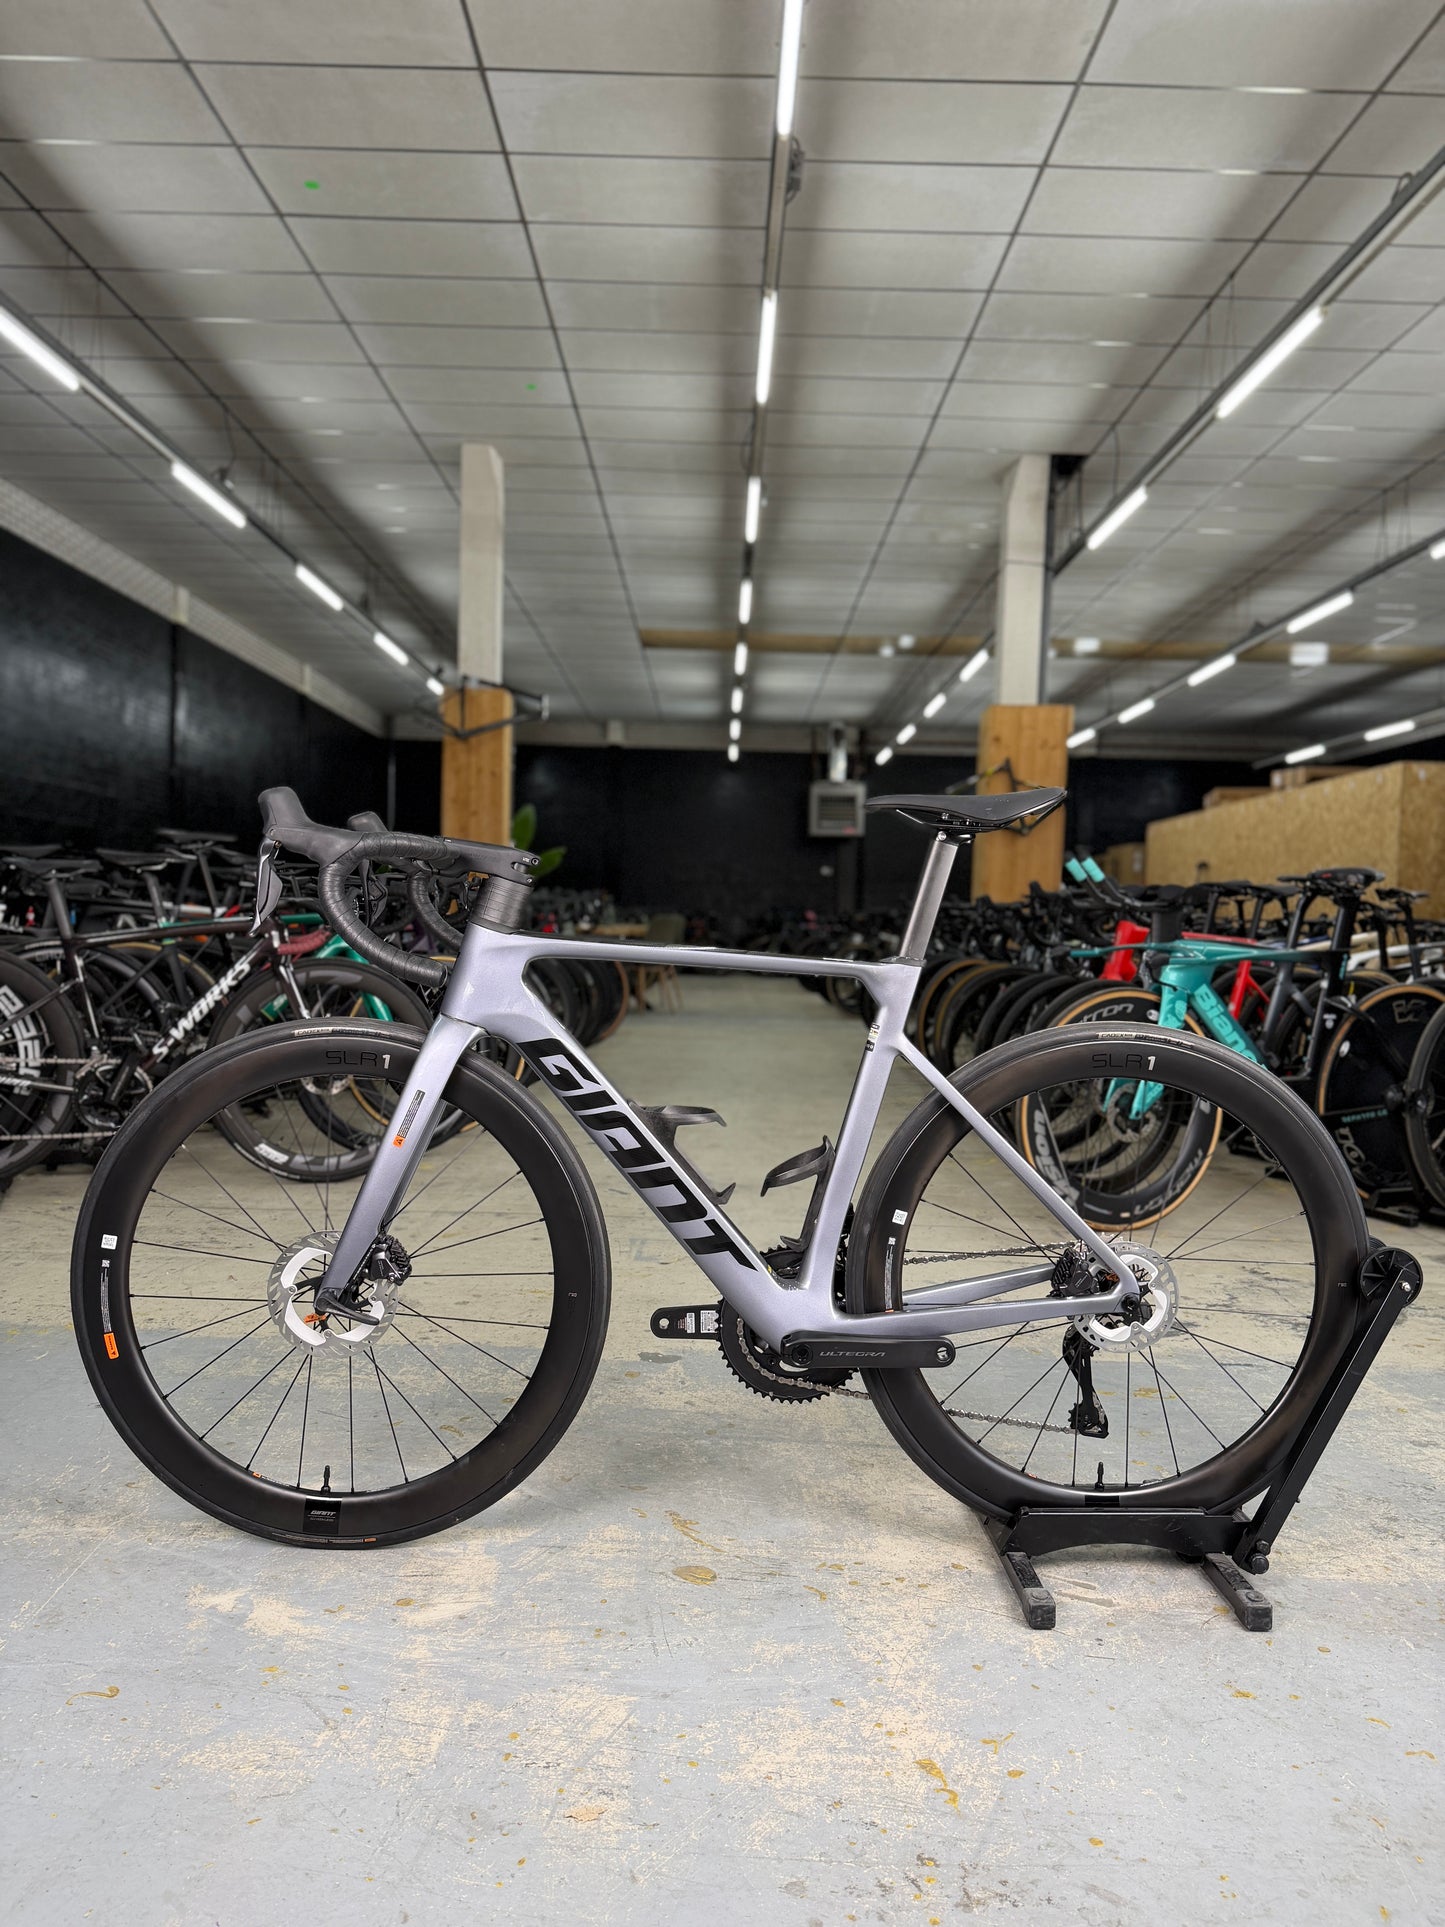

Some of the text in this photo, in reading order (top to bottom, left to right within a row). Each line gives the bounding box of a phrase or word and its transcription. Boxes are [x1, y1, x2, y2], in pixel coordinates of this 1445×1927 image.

[152, 960, 251, 1063] S-WORKS
[1194, 984, 1268, 1070] Bian
[325, 1050, 378, 1067] SLR
[1092, 1053, 1143, 1069] SLR
[516, 1038, 759, 1272] GIANT
